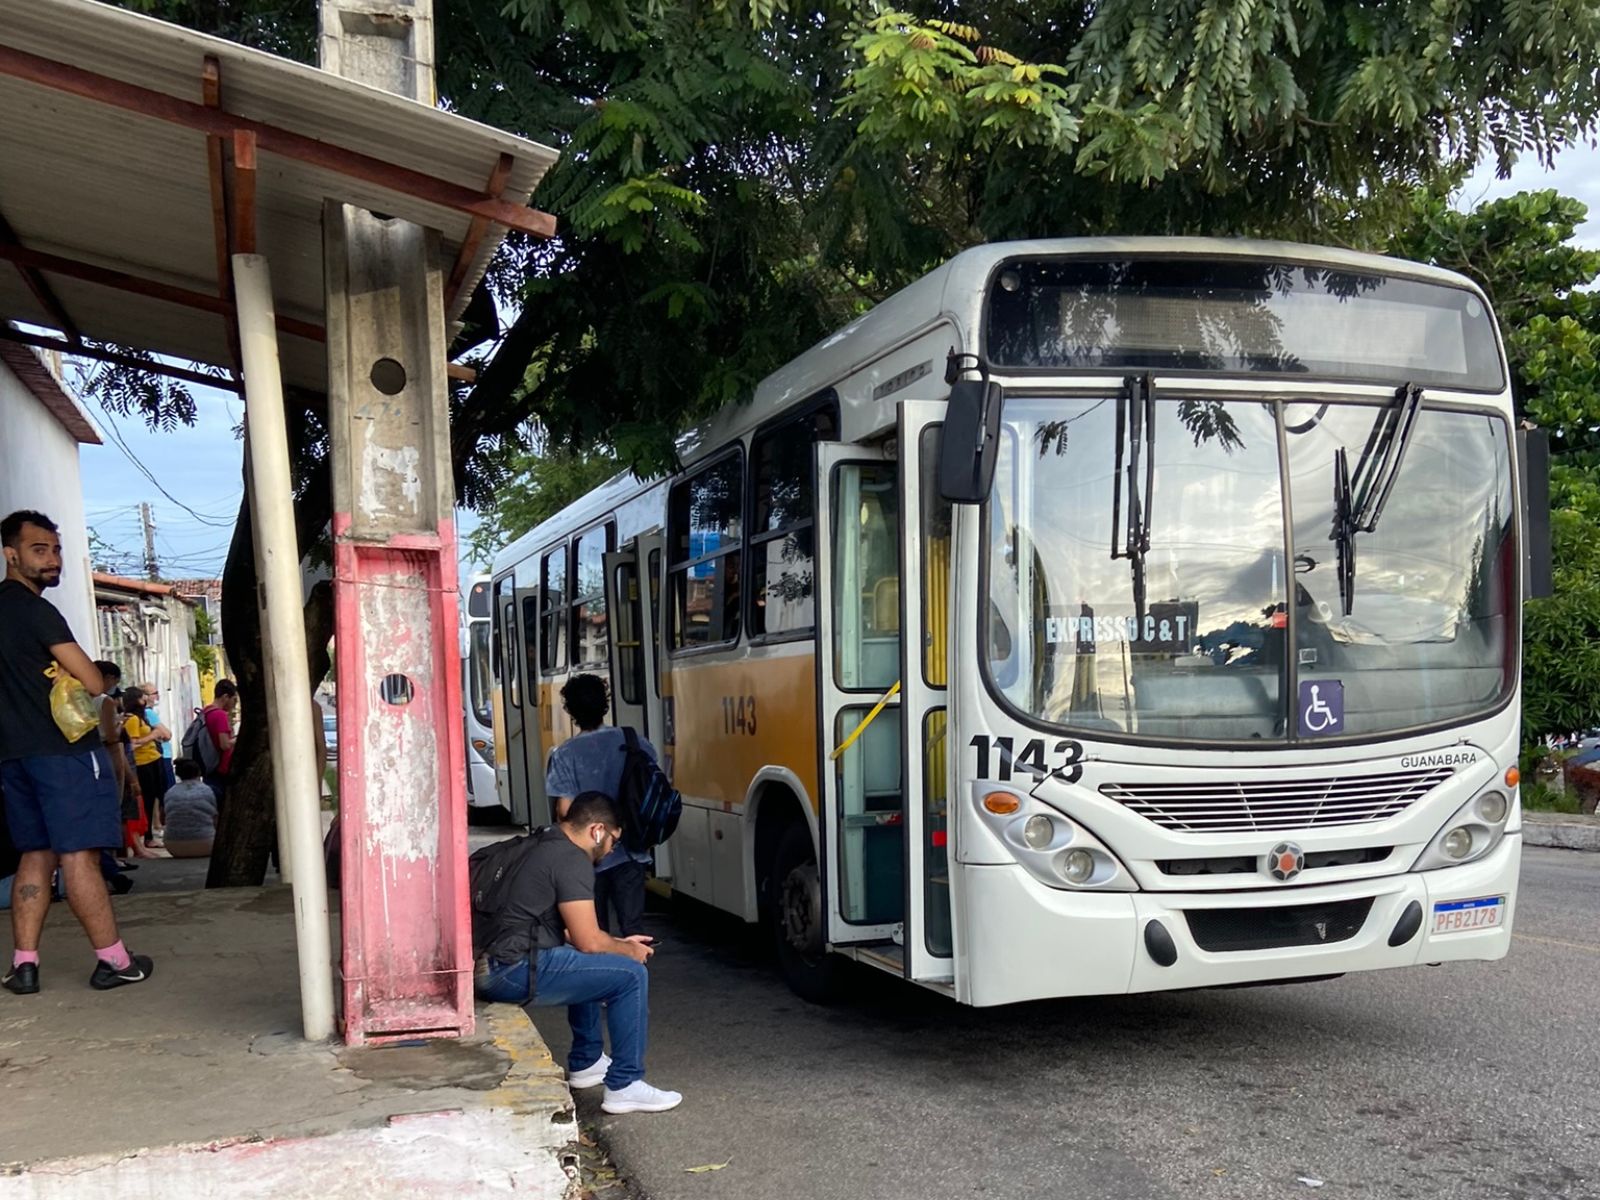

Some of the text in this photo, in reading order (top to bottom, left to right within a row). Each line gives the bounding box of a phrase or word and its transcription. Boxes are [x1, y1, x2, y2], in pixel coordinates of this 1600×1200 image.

[1046, 615, 1187, 643] EXPRESSO C & T
[722, 696, 756, 736] 1143
[969, 735, 1083, 785] 1143
[1401, 753, 1476, 768] GUANABARA
